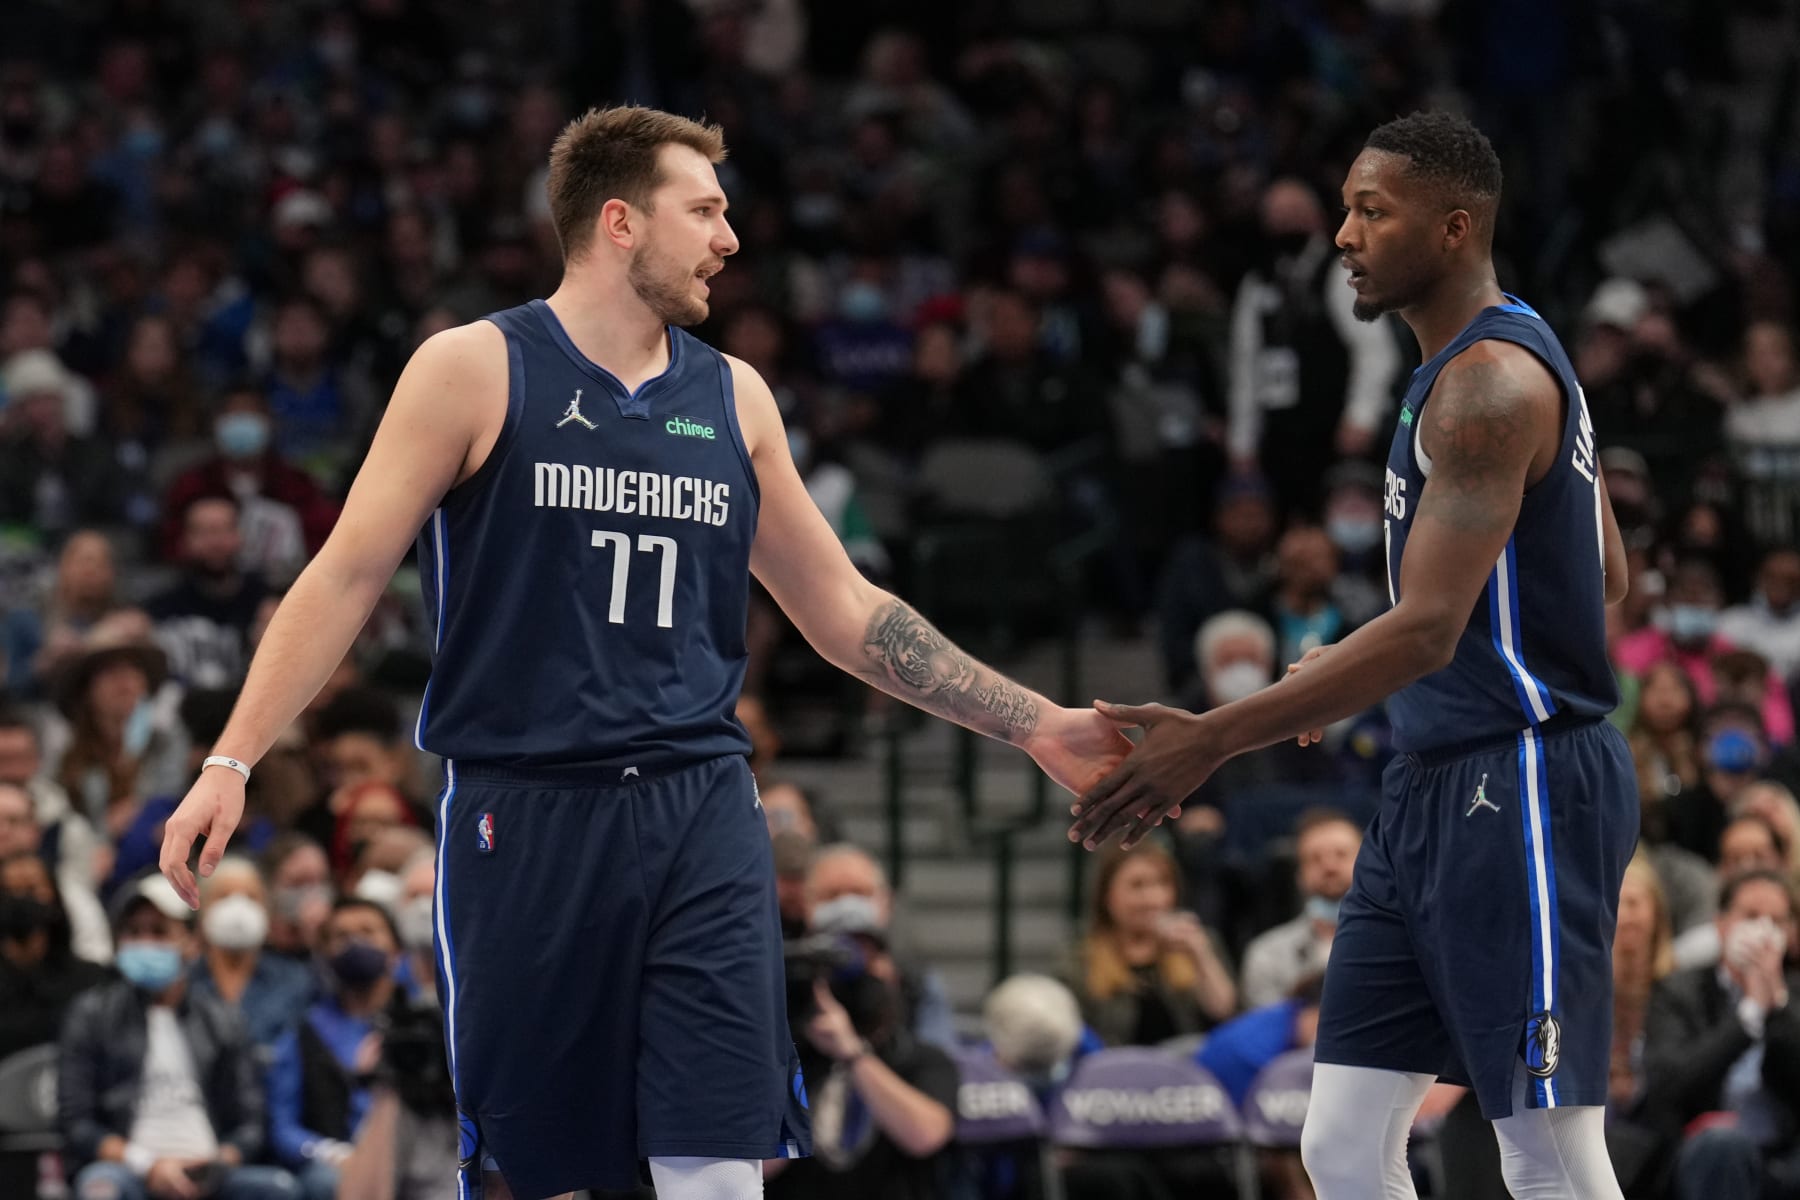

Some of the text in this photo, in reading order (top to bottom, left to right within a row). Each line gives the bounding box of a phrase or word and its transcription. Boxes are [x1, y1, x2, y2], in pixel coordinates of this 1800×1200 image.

[666, 417, 716, 440] chime
[534, 462, 730, 526] MAVERICKS
[591, 529, 678, 628] 77
[1062, 1085, 1223, 1125] VOYAGER
